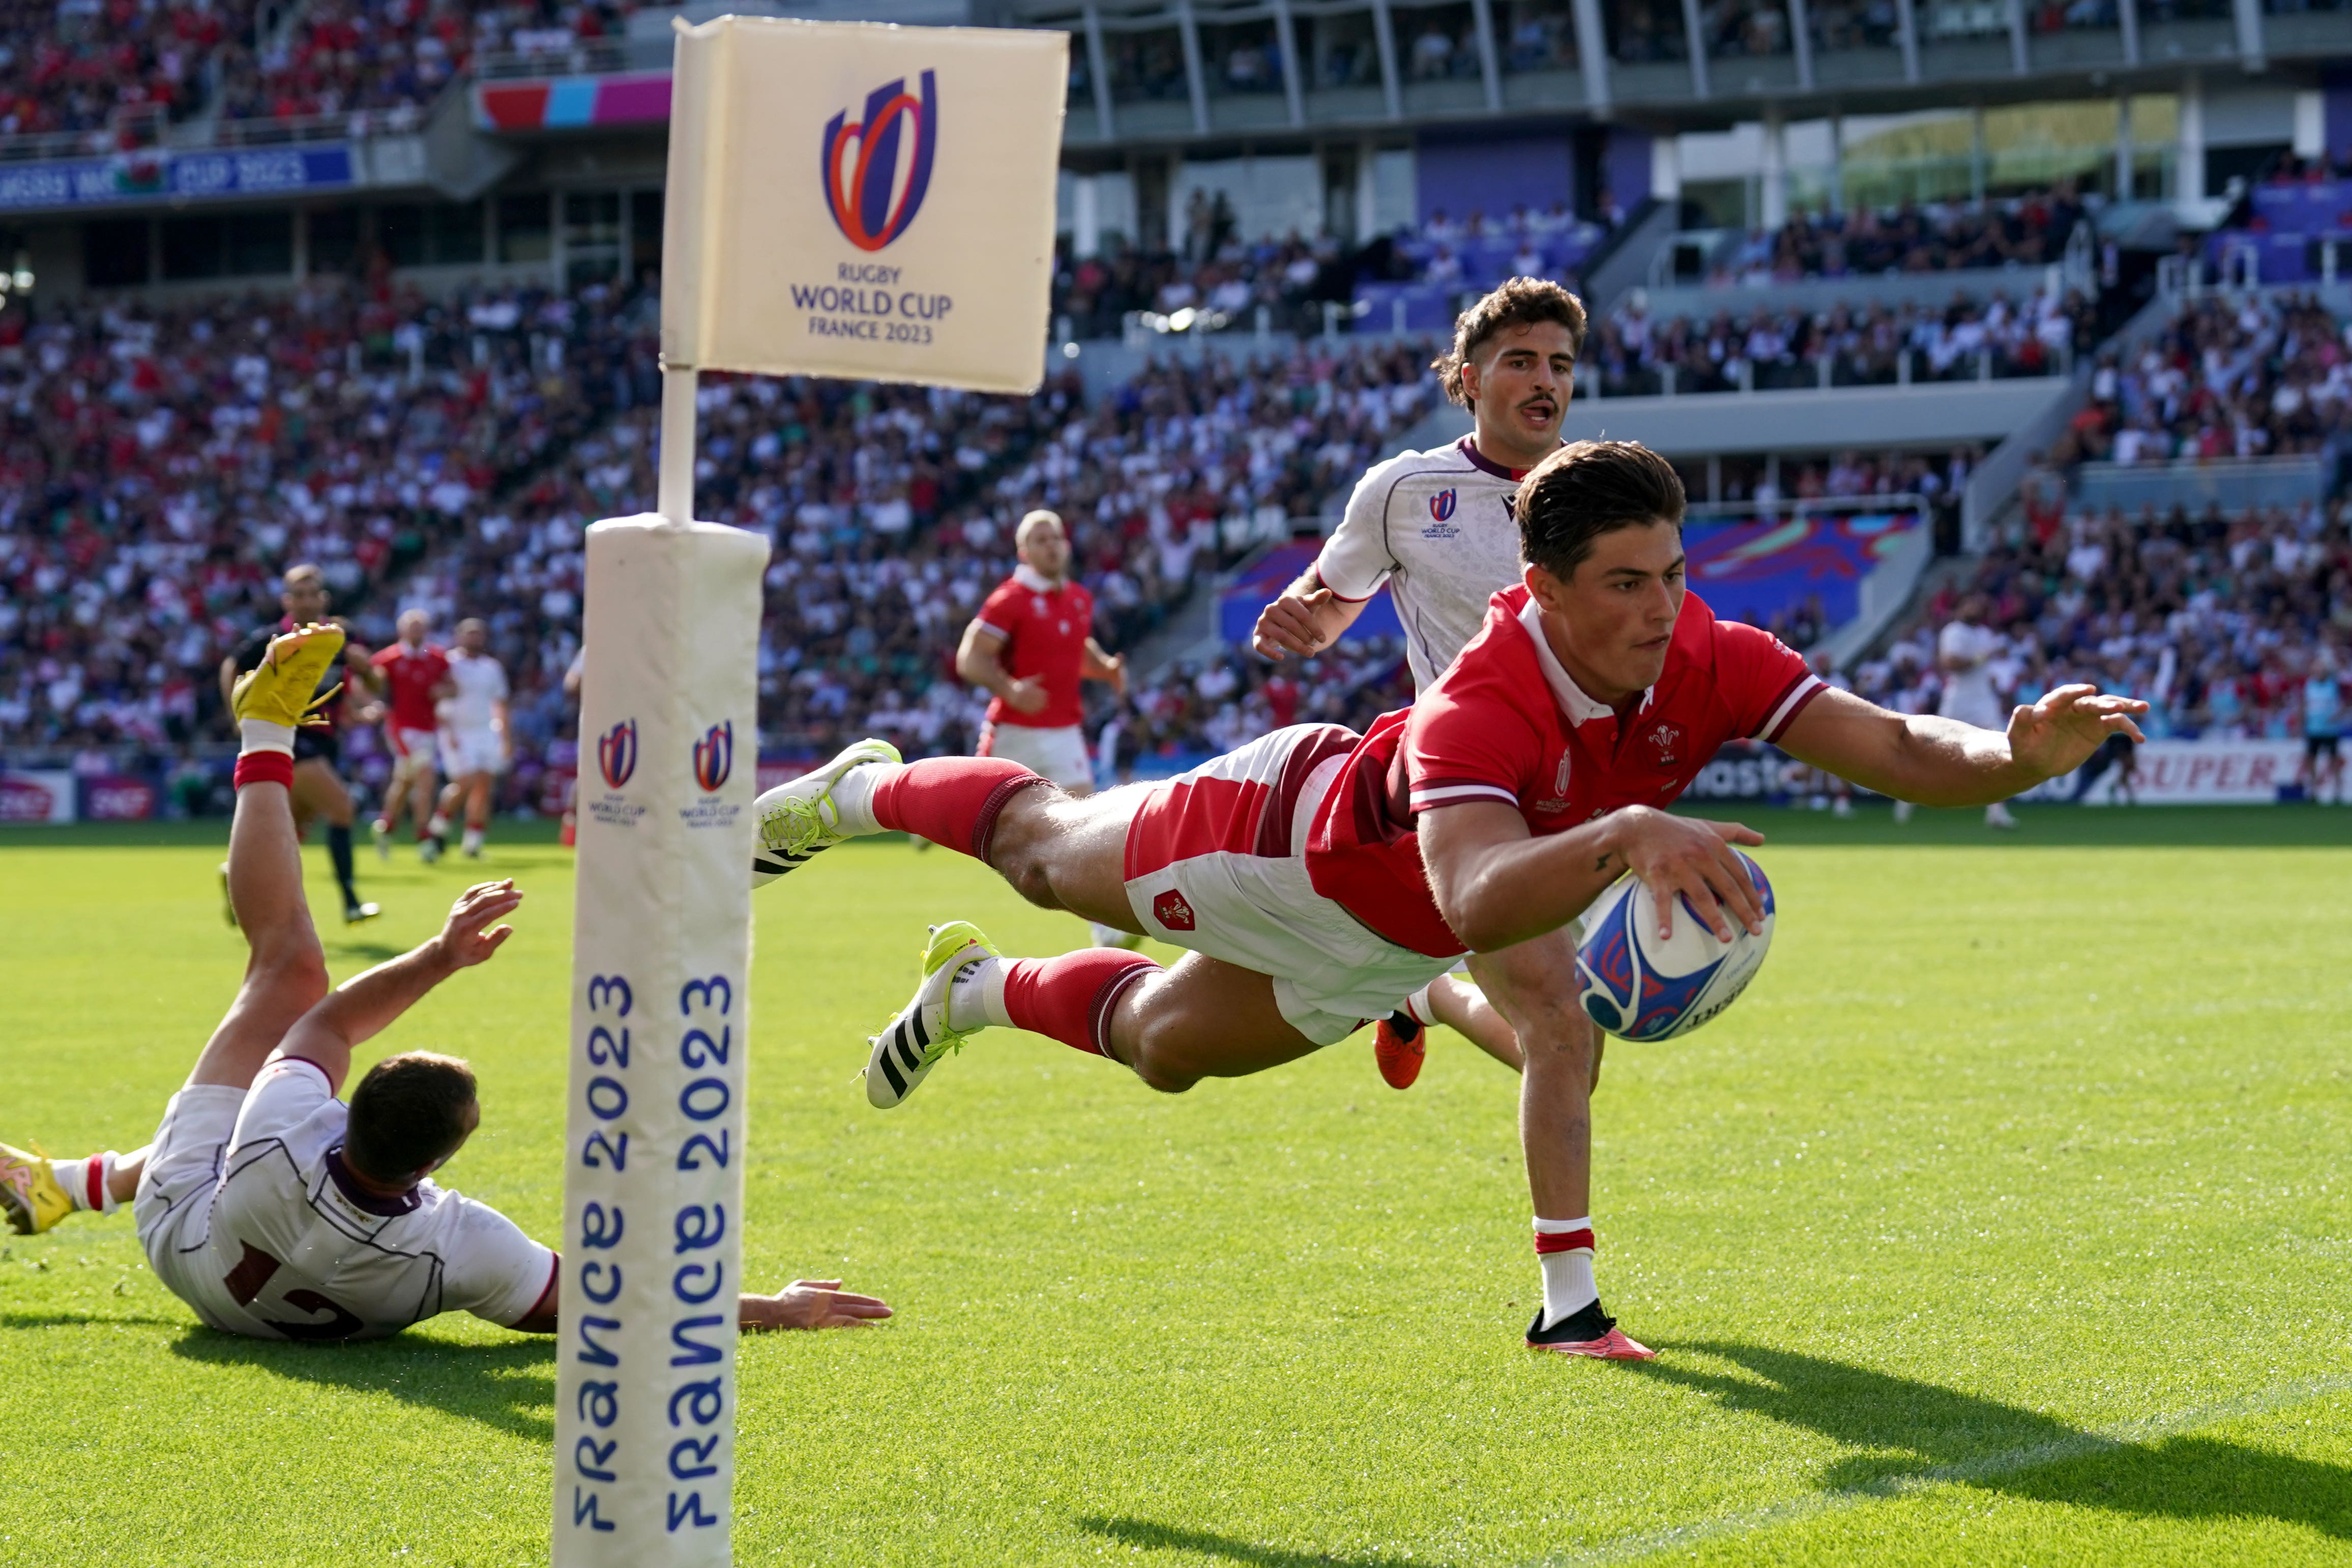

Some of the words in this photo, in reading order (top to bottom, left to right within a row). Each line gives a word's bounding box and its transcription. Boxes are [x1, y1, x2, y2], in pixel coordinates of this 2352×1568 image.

[838, 262, 902, 284] RUGBY
[790, 283, 892, 315] WORLD
[899, 291, 952, 320] CUP
[809, 316, 878, 339] FRANCE
[886, 322, 933, 344] 2023
[589, 801, 621, 814] WORLD
[622, 804, 645, 817] CUP
[679, 806, 717, 819] WORLD
[718, 803, 741, 817] CUP
[581, 973, 632, 1172] 2023
[677, 973, 731, 1171] 2023
